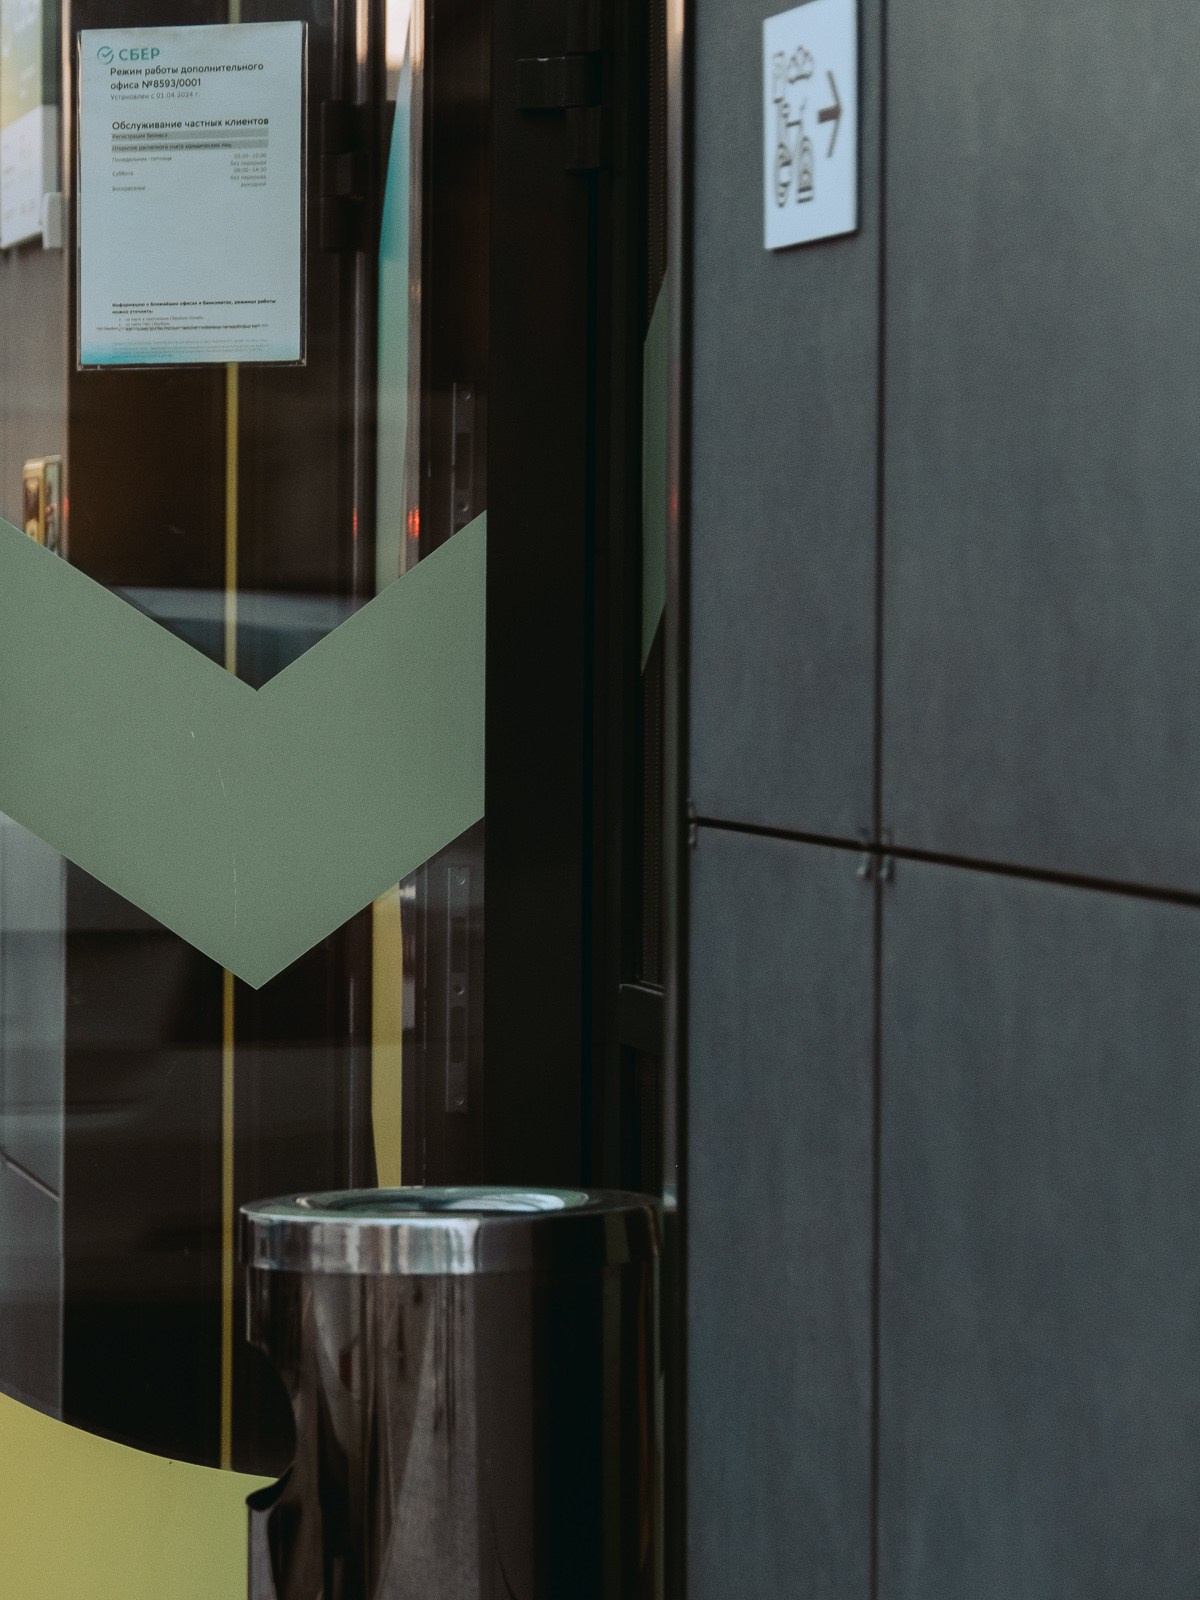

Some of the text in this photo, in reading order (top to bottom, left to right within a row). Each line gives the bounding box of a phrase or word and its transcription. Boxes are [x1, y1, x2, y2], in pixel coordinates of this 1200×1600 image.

[118, 48, 160, 61] СБЕР
[110, 63, 264, 77] Режим работы дополнительного
[110, 78, 201, 91] офиса №8593/0001
[111, 118, 269, 131] Обслуживание частных клиентов
